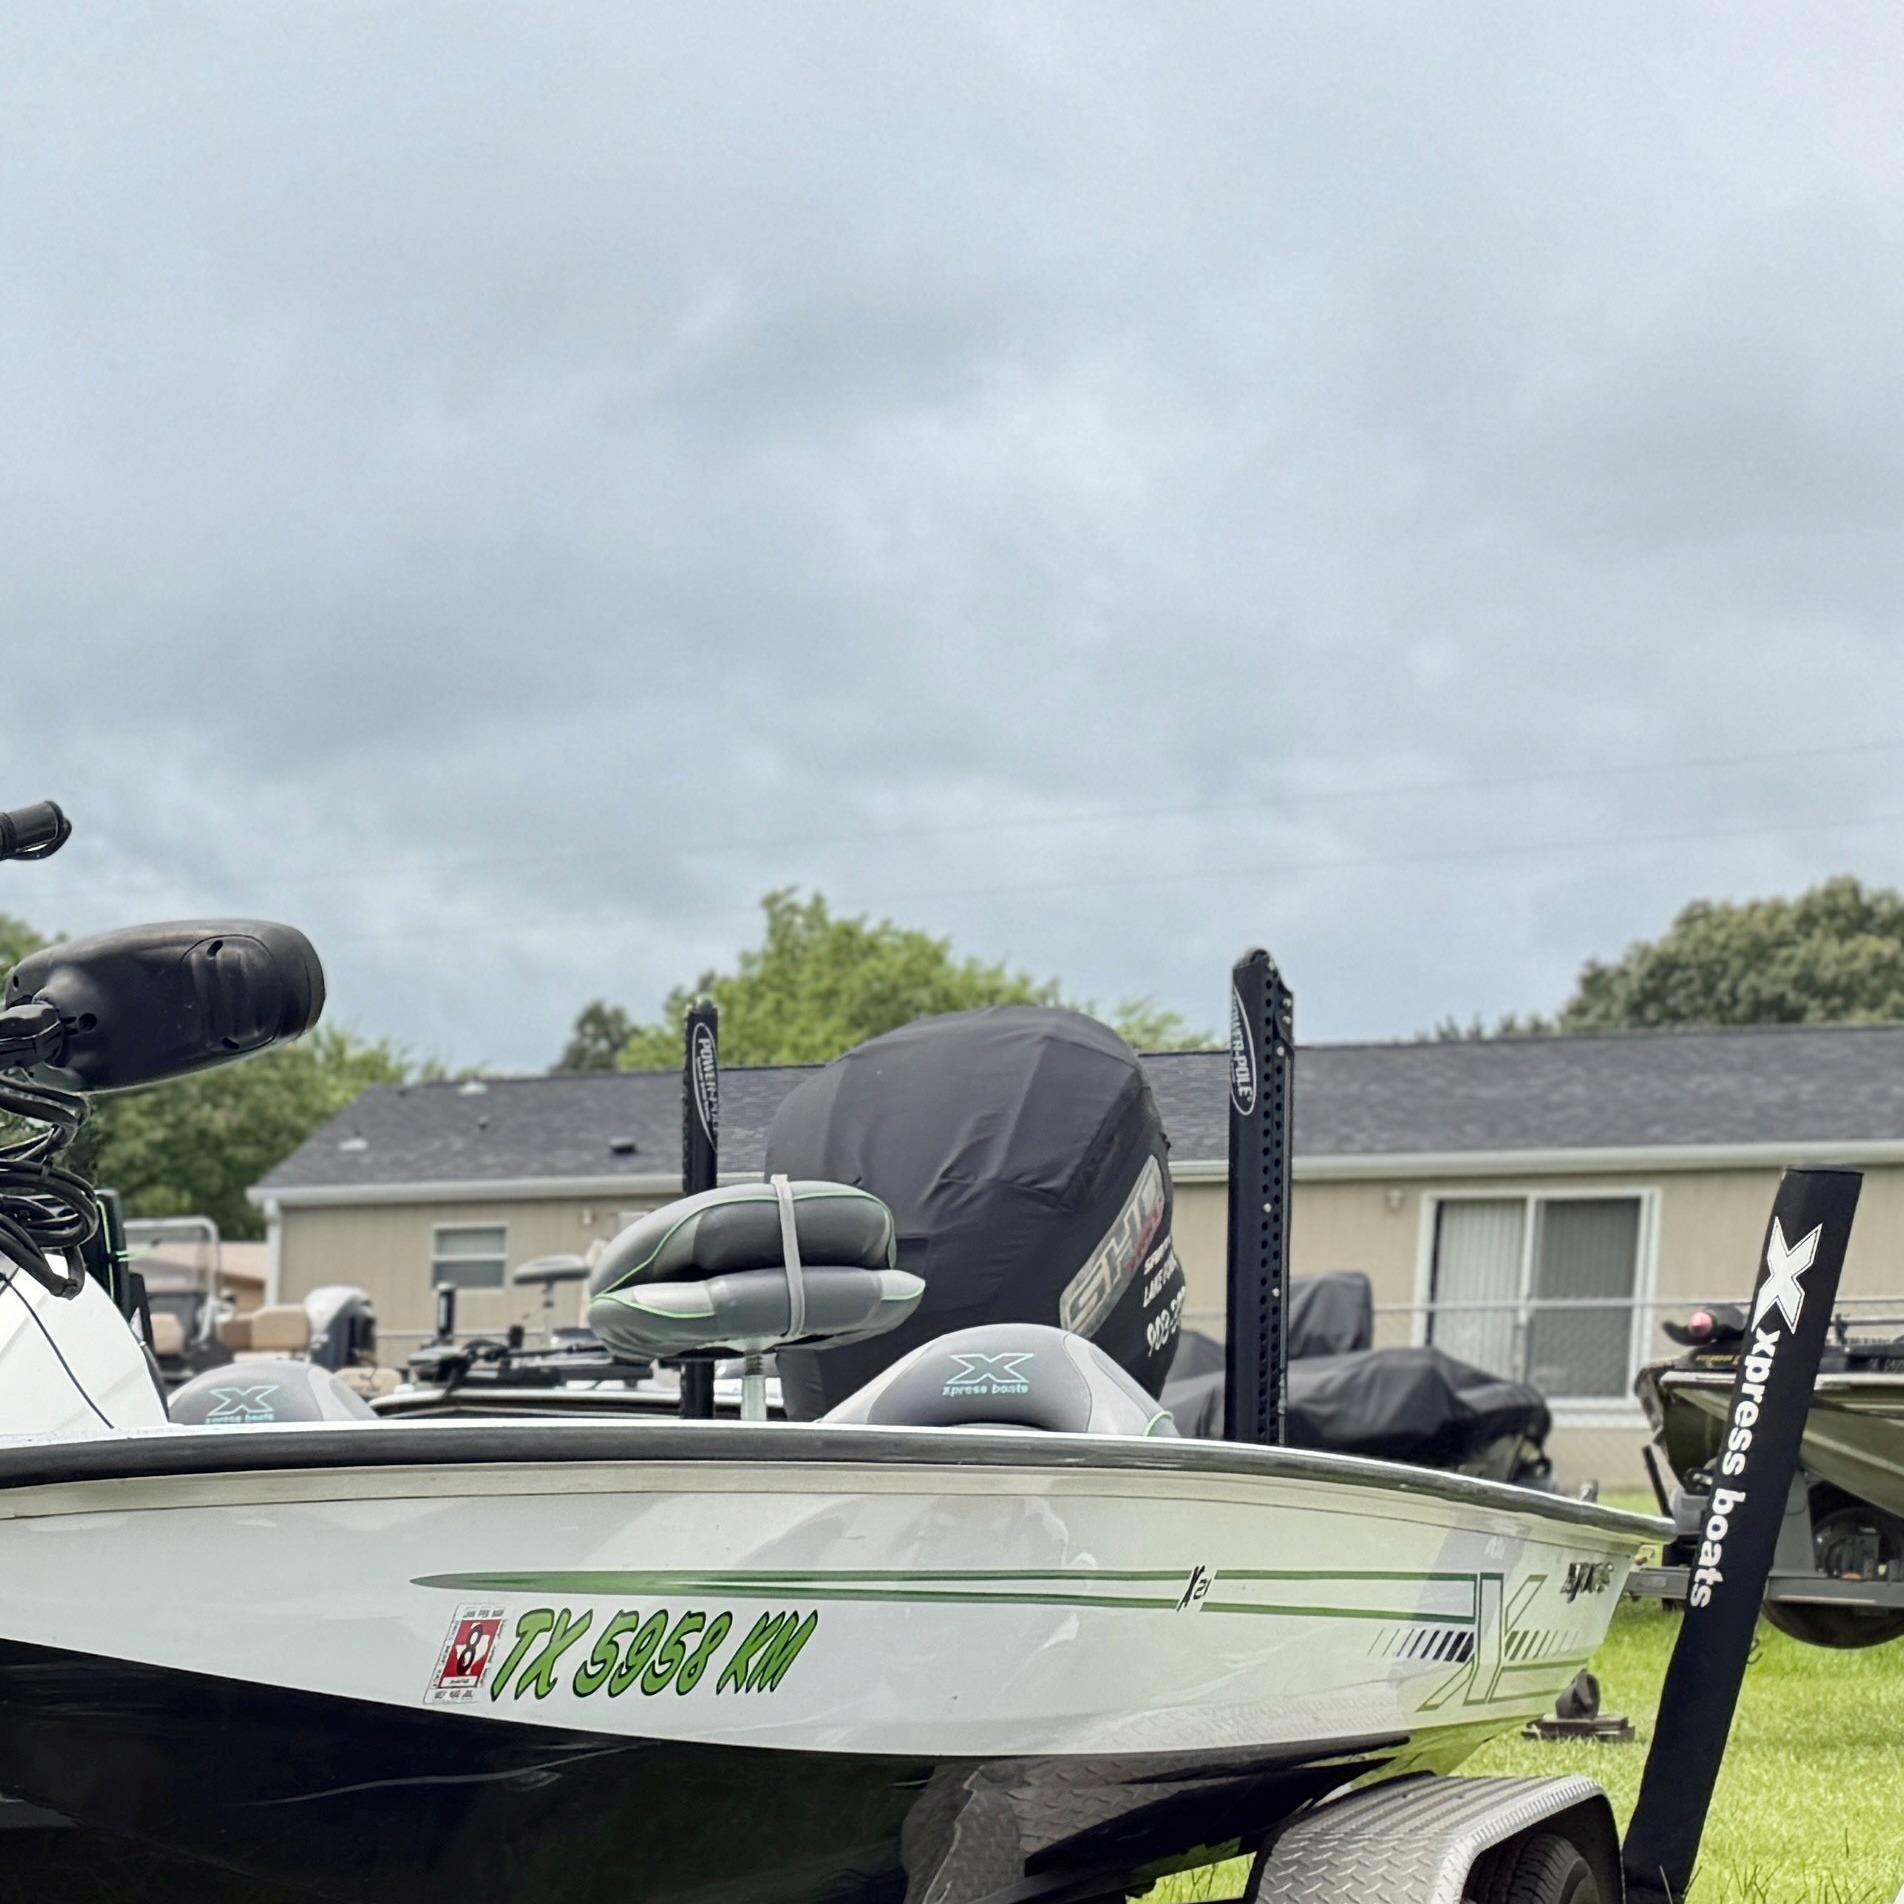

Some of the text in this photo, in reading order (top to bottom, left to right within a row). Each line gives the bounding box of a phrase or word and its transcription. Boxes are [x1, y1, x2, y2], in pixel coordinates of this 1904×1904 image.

[992, 1382, 1029, 1394] boats
[1690, 1327, 1780, 1609] xpress boats
[456, 1623, 483, 1676] 8
[490, 1608, 593, 1702] TX
[572, 1608, 734, 1698] 5958
[716, 1609, 819, 1696] KM
